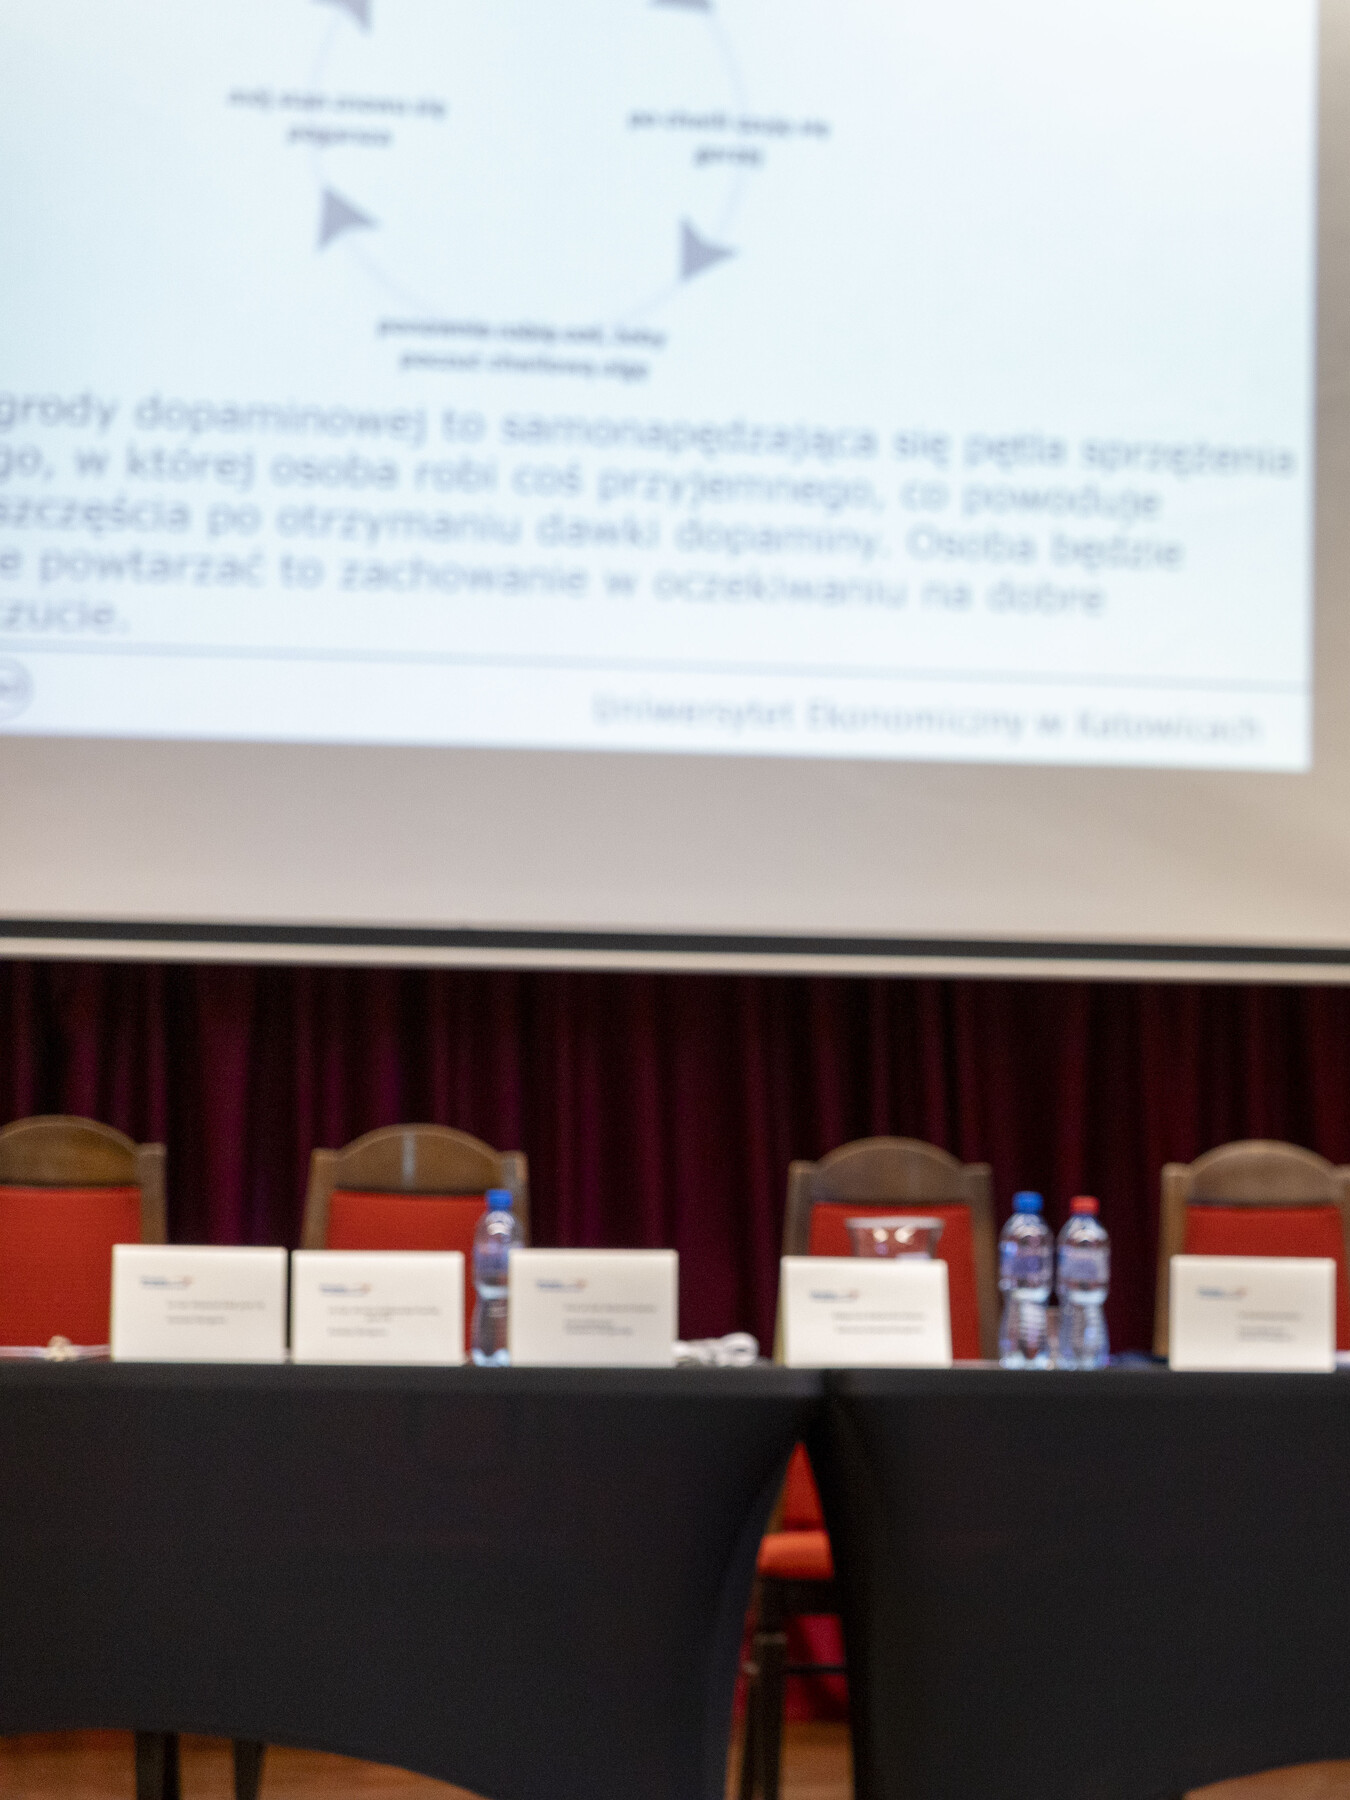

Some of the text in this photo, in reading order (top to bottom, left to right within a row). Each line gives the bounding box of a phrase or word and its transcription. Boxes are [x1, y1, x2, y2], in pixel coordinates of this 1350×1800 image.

[134, 390, 428, 450] dopaminowej
[442, 406, 487, 440] to
[500, 412, 879, 468] samonapędzająca
[75, 450, 110, 480] w
[125, 439, 256, 494] której
[270, 447, 398, 492] osoba
[414, 454, 499, 494] robi
[511, 457, 581, 498] coś
[899, 479, 951, 512] co
[206, 502, 262, 540] po
[275, 501, 521, 546] otrzymaniu
[535, 508, 660, 552] dawki
[904, 522, 1038, 562] Osoba
[0, 594, 131, 636] zucie.
[39, 543, 267, 590] powtarzać
[280, 552, 325, 590] to
[338, 551, 589, 600] zachowanie
[603, 567, 639, 600] w
[920, 579, 973, 612] na
[984, 573, 1108, 618] dobre
